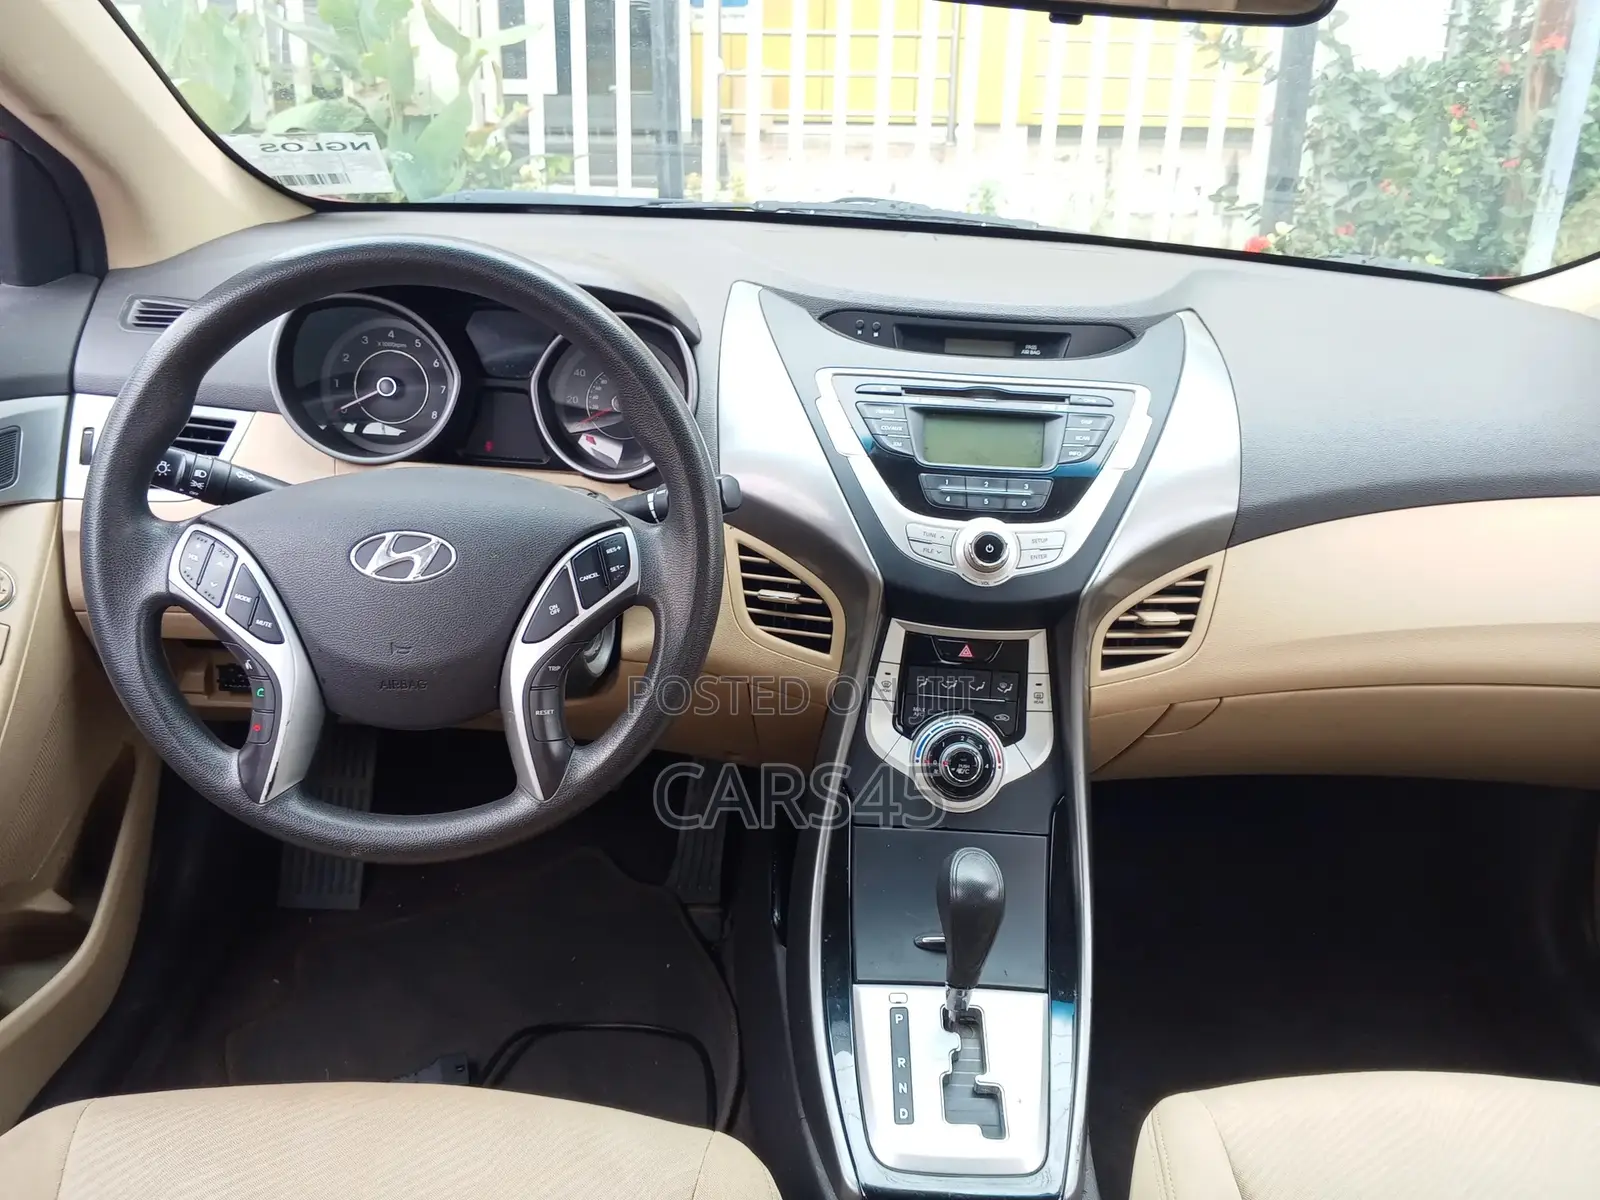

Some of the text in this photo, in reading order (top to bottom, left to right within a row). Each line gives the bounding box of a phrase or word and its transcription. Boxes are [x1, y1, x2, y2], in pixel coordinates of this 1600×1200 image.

[388, 330, 395, 338] 4
[362, 335, 369, 345] 3
[415, 338, 422, 348] 5
[343, 353, 350, 362] 2
[433, 359, 440, 367] 6
[573, 368, 586, 377] 40
[334, 378, 339, 388] 1
[441, 386, 447, 394] 7
[567, 394, 579, 404] 20
[431, 411, 438, 420] 8
[1031, 537, 1048, 545] SETUP
[1030, 553, 1048, 561] ENTER
[579, 571, 601, 582] CANCEL
[234, 593, 252, 603] MODE
[549, 603, 558, 611] ON
[255, 619, 273, 629] MUTE
[548, 664, 561, 672] TRIP
[378, 679, 428, 691] AIRBAG
[535, 708, 555, 716] RESET
[895, 1014, 903, 1024] P
[898, 1057, 906, 1068] R
[899, 1083, 907, 1094] N
[900, 1108, 908, 1119] D
